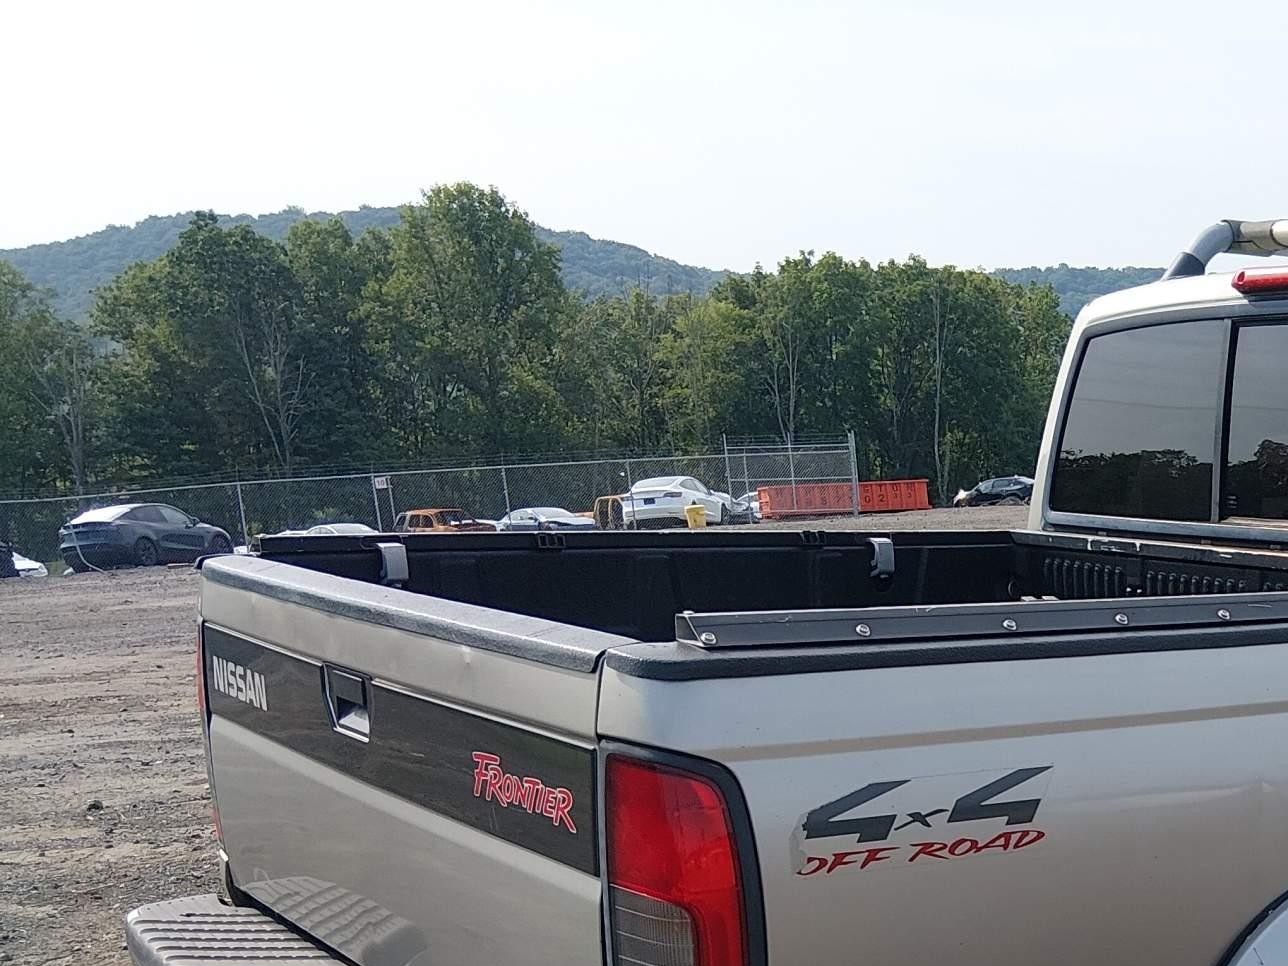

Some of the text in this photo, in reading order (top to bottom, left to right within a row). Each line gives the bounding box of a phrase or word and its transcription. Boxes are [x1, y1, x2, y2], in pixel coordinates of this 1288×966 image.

[212, 655, 268, 712] NISSAN
[796, 829, 1046, 876] OFF ROAD
